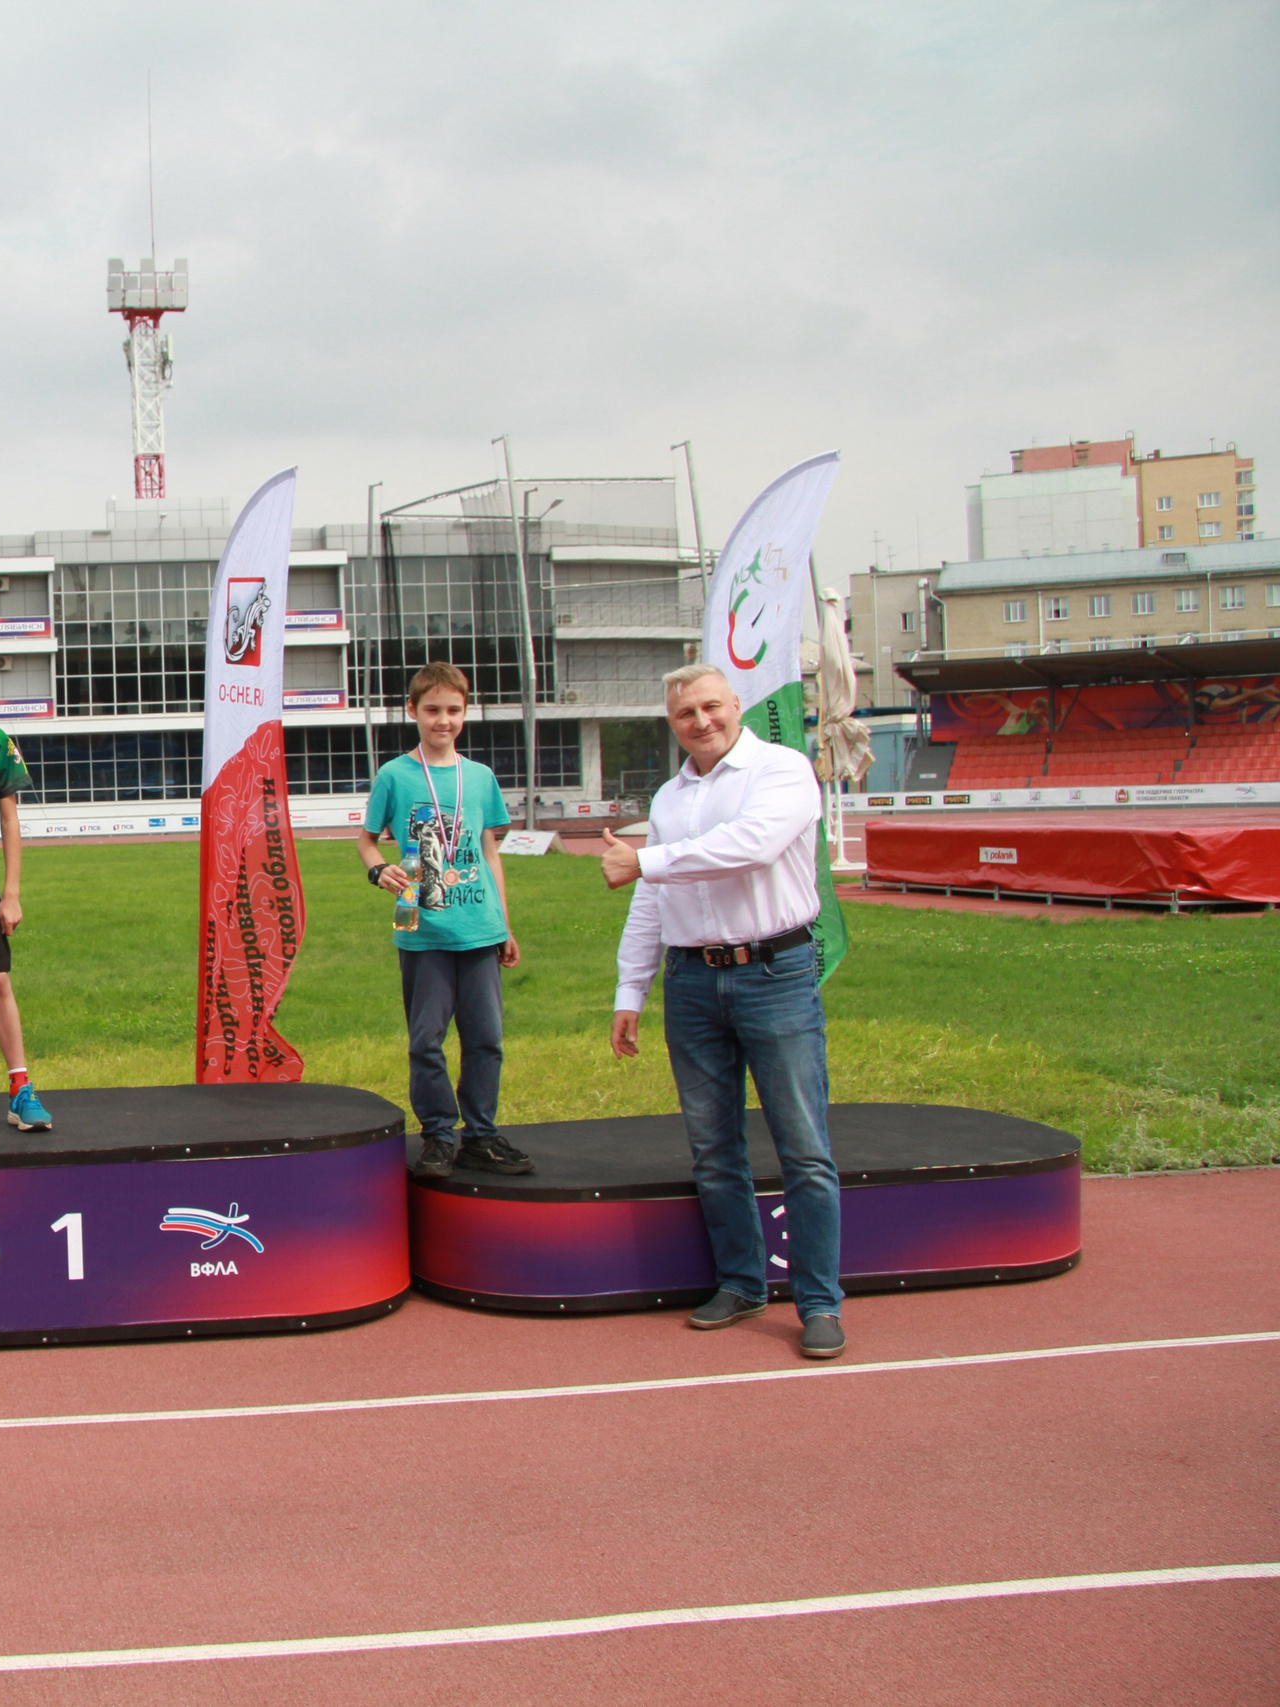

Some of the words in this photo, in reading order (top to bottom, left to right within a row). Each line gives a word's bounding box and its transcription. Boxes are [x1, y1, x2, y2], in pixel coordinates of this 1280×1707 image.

[260, 777, 289, 892] области
[50, 1212, 84, 1281] 1
[189, 1260, 239, 1278] ВФЛА
